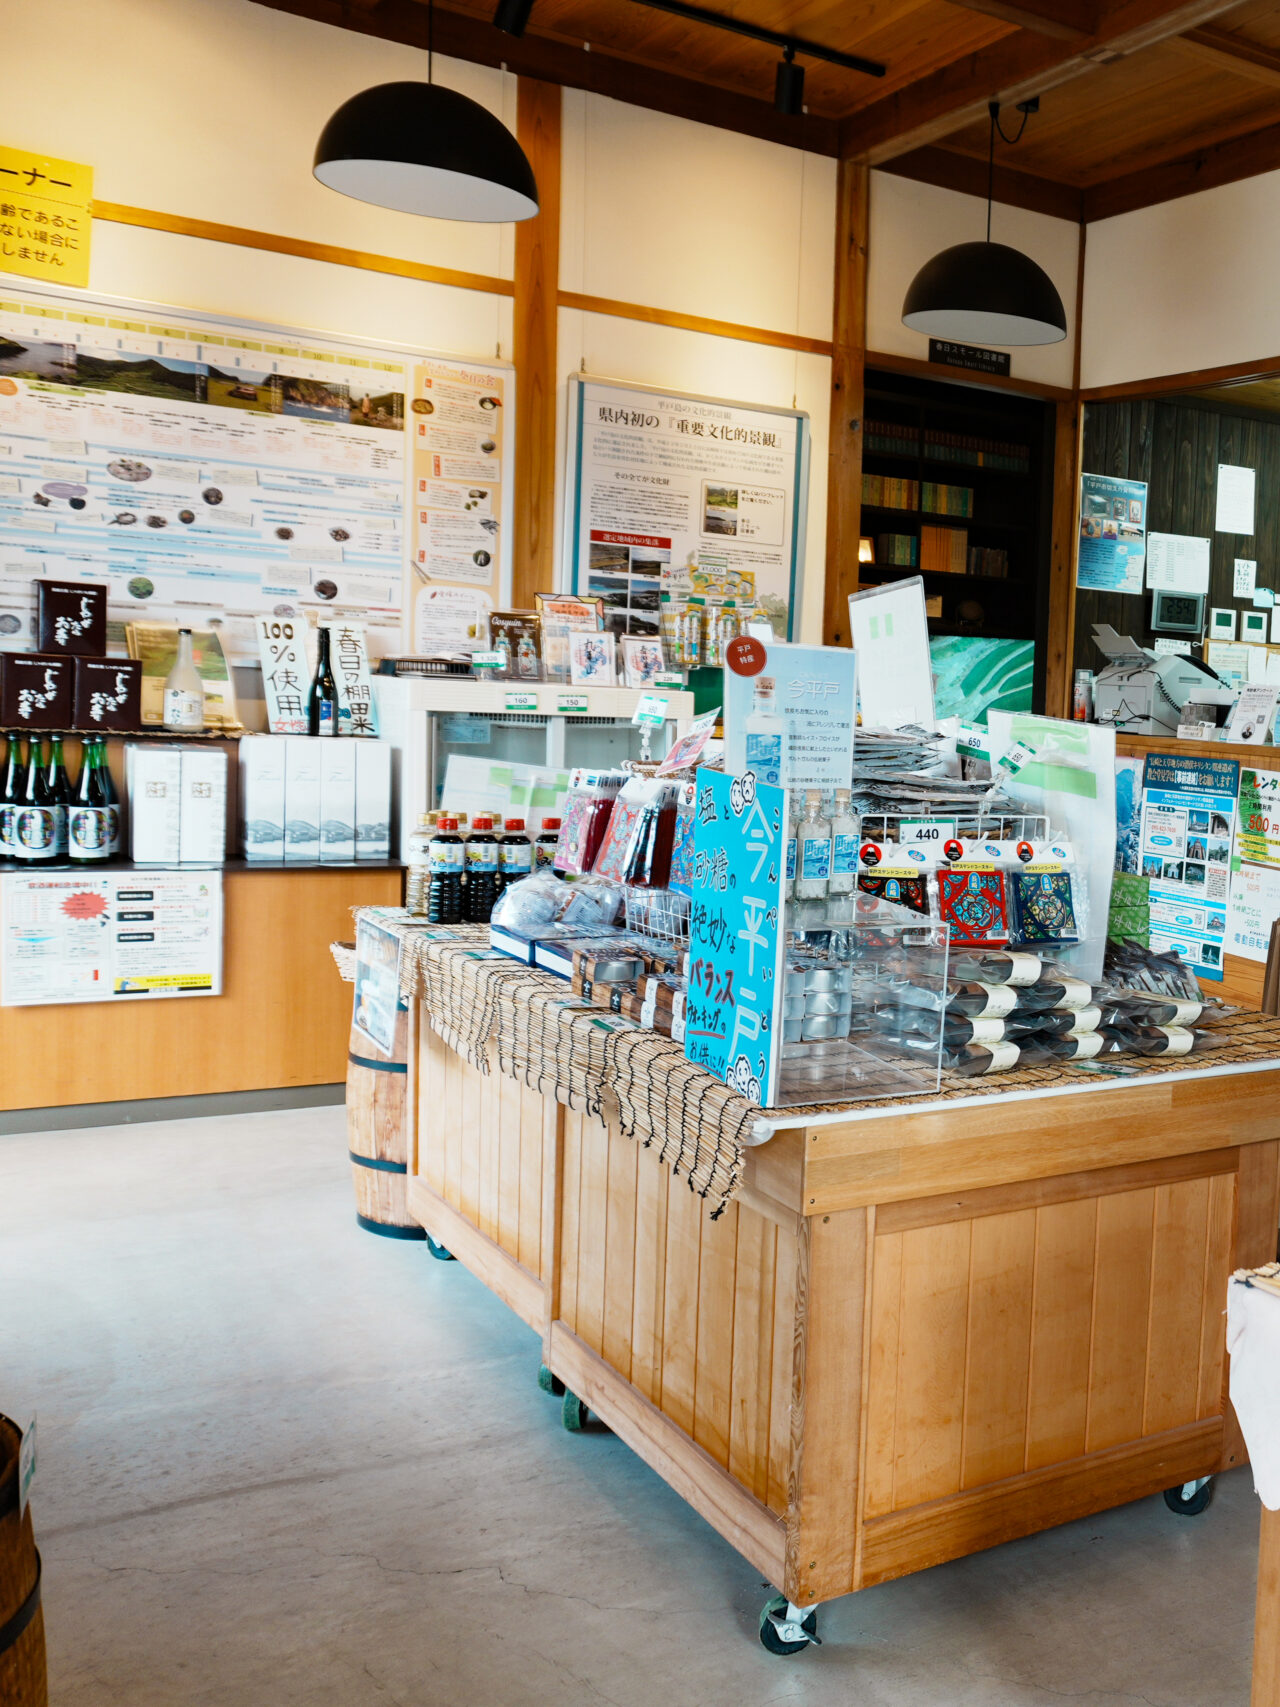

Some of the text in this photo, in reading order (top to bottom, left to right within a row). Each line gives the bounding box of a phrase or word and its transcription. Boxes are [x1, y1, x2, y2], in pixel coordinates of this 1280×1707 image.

[0, 203, 79, 231] 齢であるこ
[0, 223, 79, 250] ない場合に
[3, 242, 64, 267] しません
[599, 406, 783, 449] 県内初の『重要文化的景観』
[737, 644, 751, 653] 平戸
[739, 655, 755, 664] 特産
[788, 679, 841, 700] 今平戸
[968, 737, 981, 747] 650
[915, 828, 940, 840] 440
[1249, 814, 1279, 834] 500 円
[694, 846, 737, 892] 砂糖の
[728, 797, 775, 1063] 今平戸
[690, 958, 736, 1008] バランス
